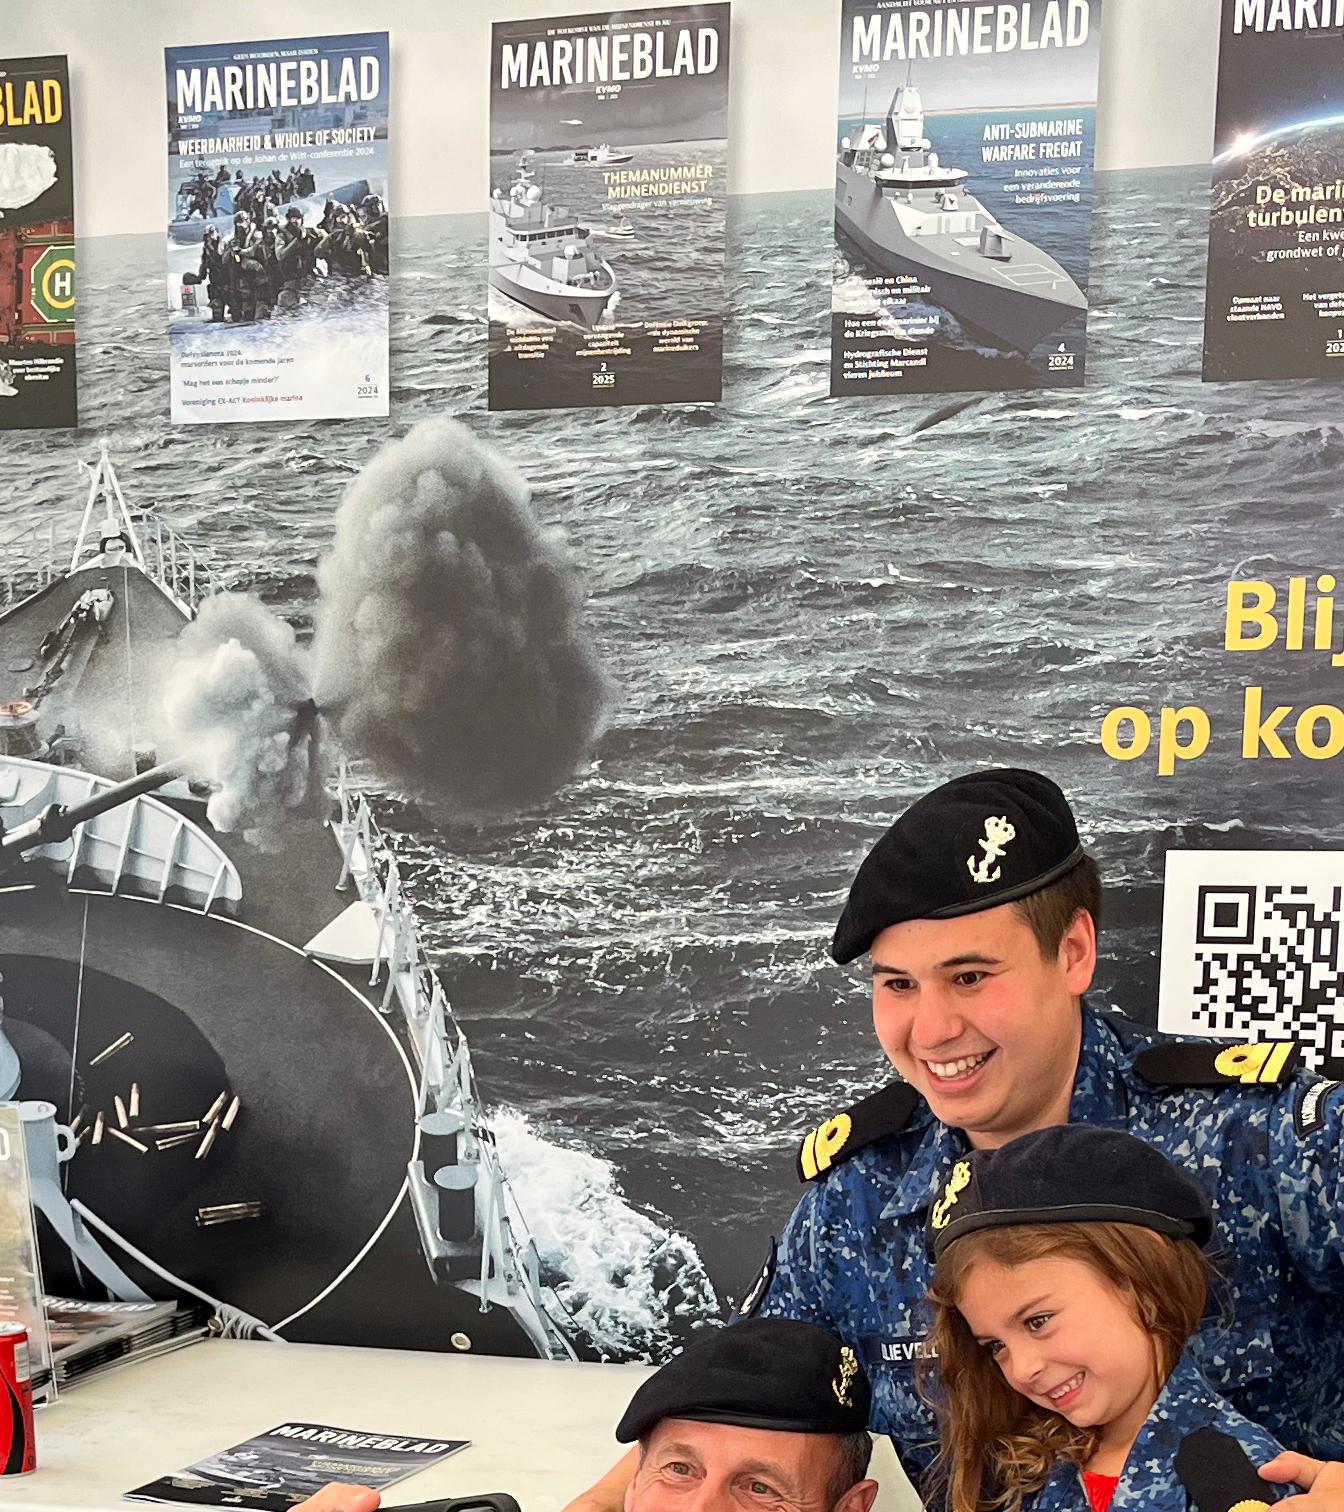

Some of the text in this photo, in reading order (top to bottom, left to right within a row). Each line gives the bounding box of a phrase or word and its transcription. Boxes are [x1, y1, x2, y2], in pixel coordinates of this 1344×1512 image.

[852, 0, 1089, 62] MARINEBLAD
[501, 27, 718, 89] MARINEBLAD
[852, 64, 879, 73] KVMO
[176, 56, 380, 113] MARINEBLAD
[595, 85, 621, 94] KVMO
[178, 115, 202, 124] KVMO
[983, 119, 1083, 140] ANTI-SUBMARINE
[178, 127, 376, 156] WEERBAARHEID & WHOLE OF SOCIETY
[242, 155, 252, 164] de
[254, 154, 276, 163] Johan
[290, 149, 354, 161] Witt-conferentie
[982, 141, 1082, 162] WARFARE FREGAT
[603, 165, 713, 184] THEMANUMMER
[1015, 167, 1059, 177] Innovaties
[608, 180, 707, 199] MIJNENDIENST
[1021, 179, 1080, 190] veranderende
[1016, 193, 1080, 204] bedrijfsvoering
[1257, 186, 1285, 205] De
[1298, 231, 1319, 243] Een
[1266, 244, 1323, 262] grondwet
[1327, 243, 1339, 256] of
[55, 272, 71, 296] H
[844, 319, 860, 328] Hoe
[1337, 329, 1342, 338] 1
[1057, 343, 1065, 352] 4
[1048, 356, 1074, 367] 2024
[593, 375, 615, 384] 2025
[1100, 705, 1210, 776] op
[270, 1425, 451, 1454] MARINEBLAD
